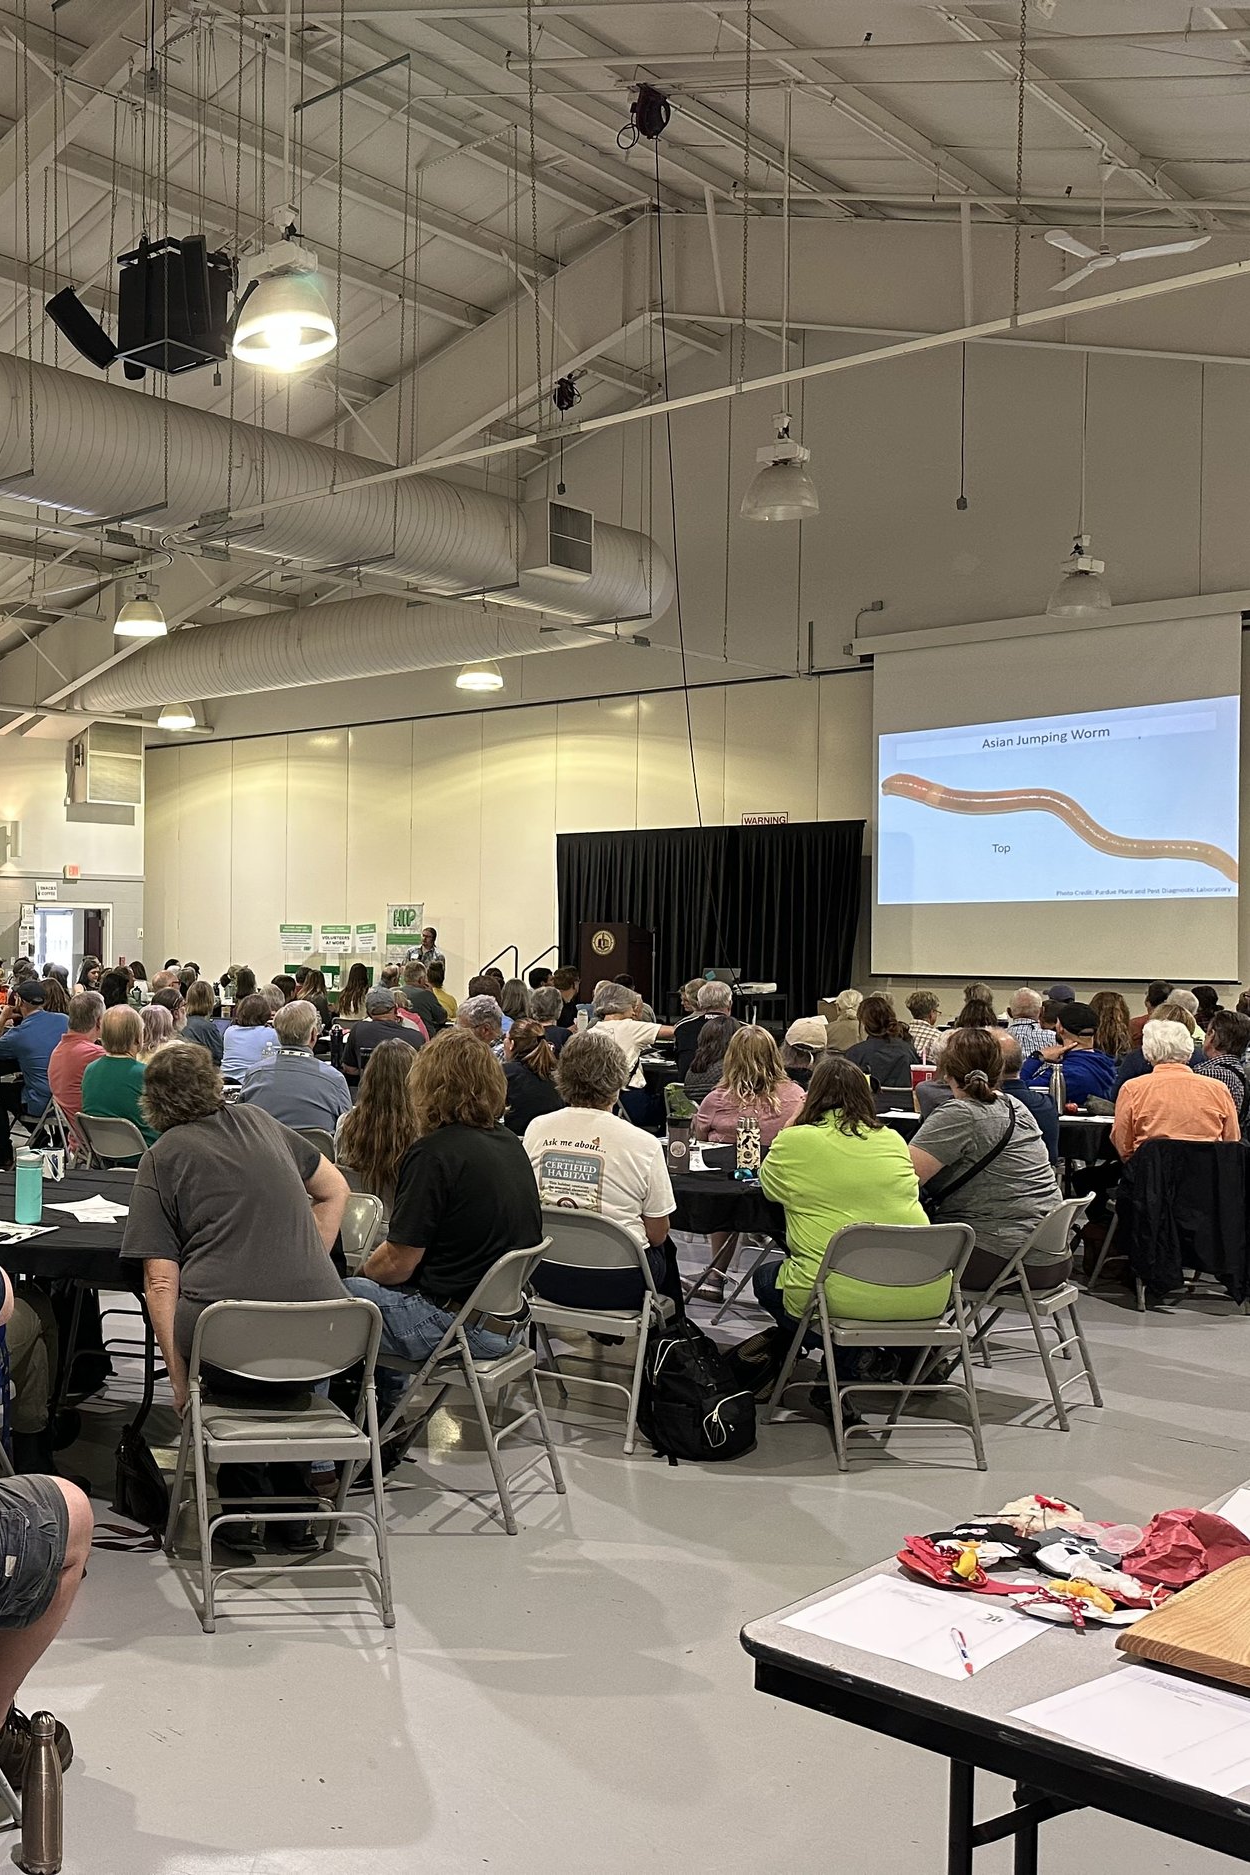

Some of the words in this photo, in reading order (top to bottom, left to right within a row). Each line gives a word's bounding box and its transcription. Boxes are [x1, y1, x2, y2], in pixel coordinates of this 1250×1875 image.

[982, 738, 1014, 749] Asian
[1016, 732, 1068, 746] Jumping
[1071, 728, 1110, 740] Worm
[744, 816, 786, 825] WARNING
[992, 844, 1011, 854] Top
[393, 908, 416, 927] HIP
[542, 1138, 558, 1146] Ask
[574, 1140, 606, 1153] about...
[545, 1161, 597, 1174] CERTIFIED
[547, 1169, 593, 1181] HABITAT
